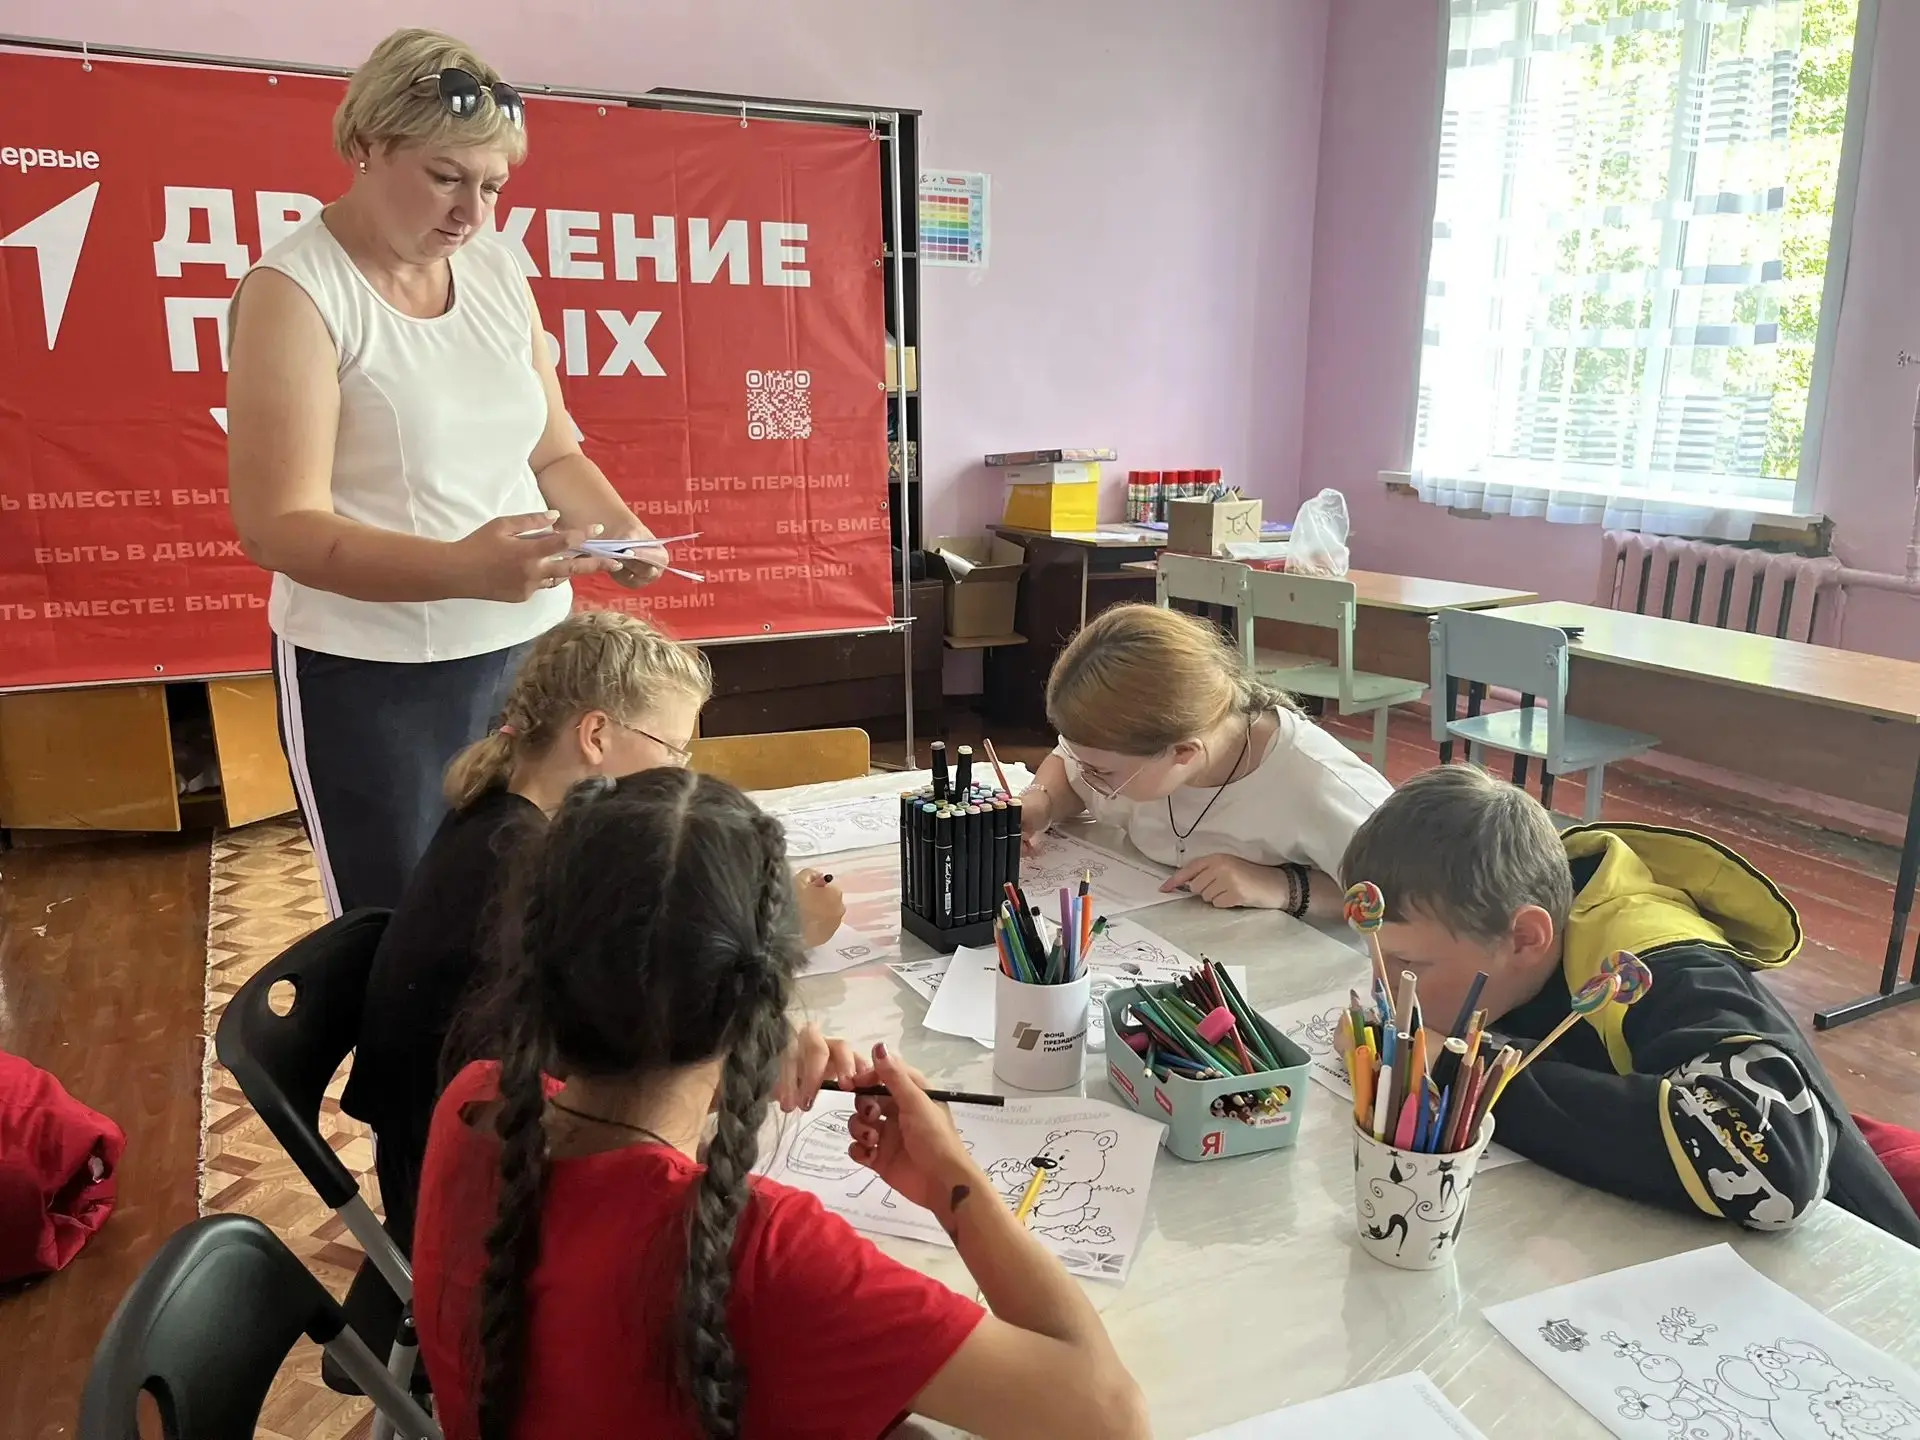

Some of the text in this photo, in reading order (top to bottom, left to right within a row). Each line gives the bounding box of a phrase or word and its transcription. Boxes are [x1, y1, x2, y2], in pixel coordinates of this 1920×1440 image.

[0, 147, 100, 174] ервые
[153, 185, 811, 288] ДВЕНИЕ
[686, 473, 850, 492] БЫТЬ ПЕРВЫМ!
[27, 490, 161, 510] ВМЕСТЕ!
[171, 488, 230, 506] БЫТ
[628, 499, 710, 516] РВЫМ!
[776, 516, 891, 535] БЫТЬ ВМЕС
[34, 540, 245, 564] БЫТЬ В ДВИЖ
[669, 545, 736, 563] ЕСТЕ!
[756, 563, 853, 581] ПЕРВЫМ!
[0, 593, 266, 621] ТЬ ВМЕСТЕ! БЫТЬ
[1043, 1031, 1065, 1039] ФОНД
[1043, 1044, 1073, 1053] ГРАНТОВ
